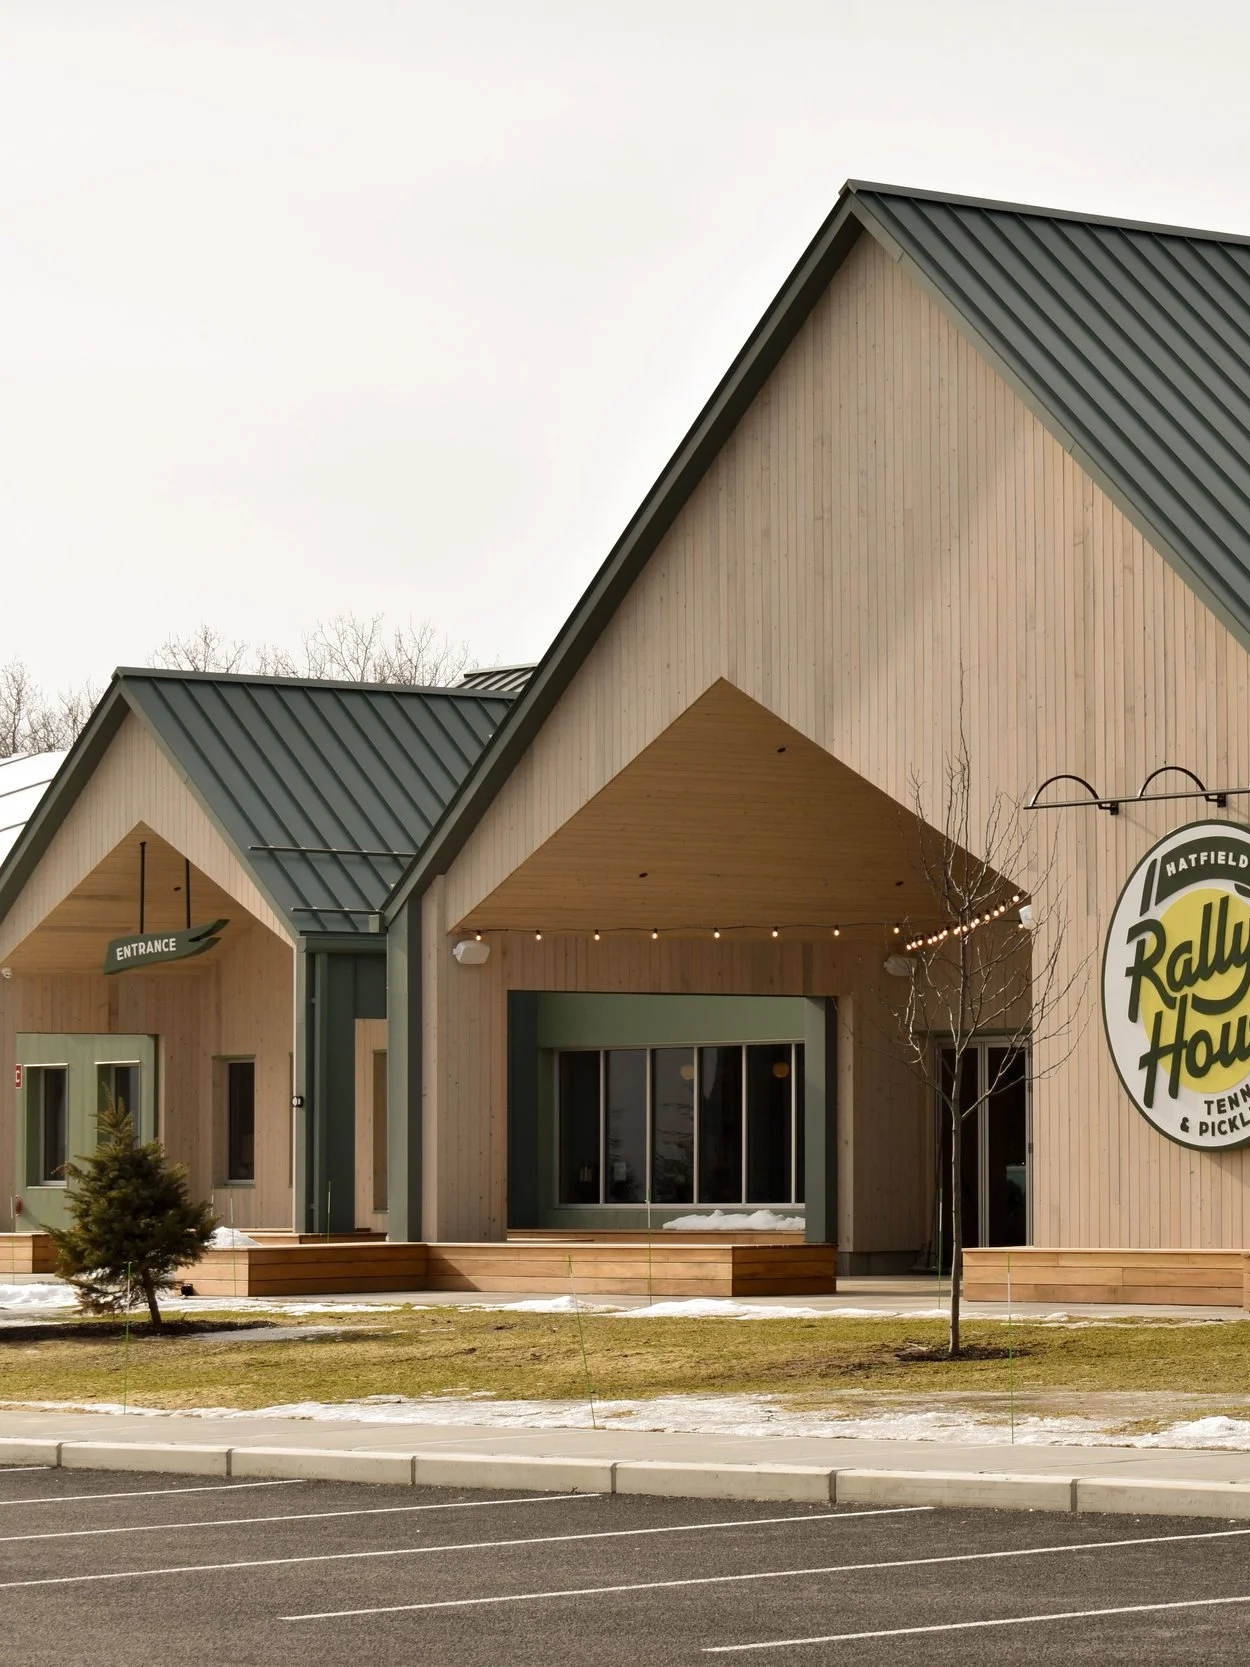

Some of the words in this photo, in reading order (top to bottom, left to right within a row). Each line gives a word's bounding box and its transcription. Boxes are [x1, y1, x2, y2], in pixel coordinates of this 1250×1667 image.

[1166, 851, 1249, 877] HATFIELD
[116, 938, 177, 961] ENTRANCE
[1180, 1116, 1190, 1133] &
